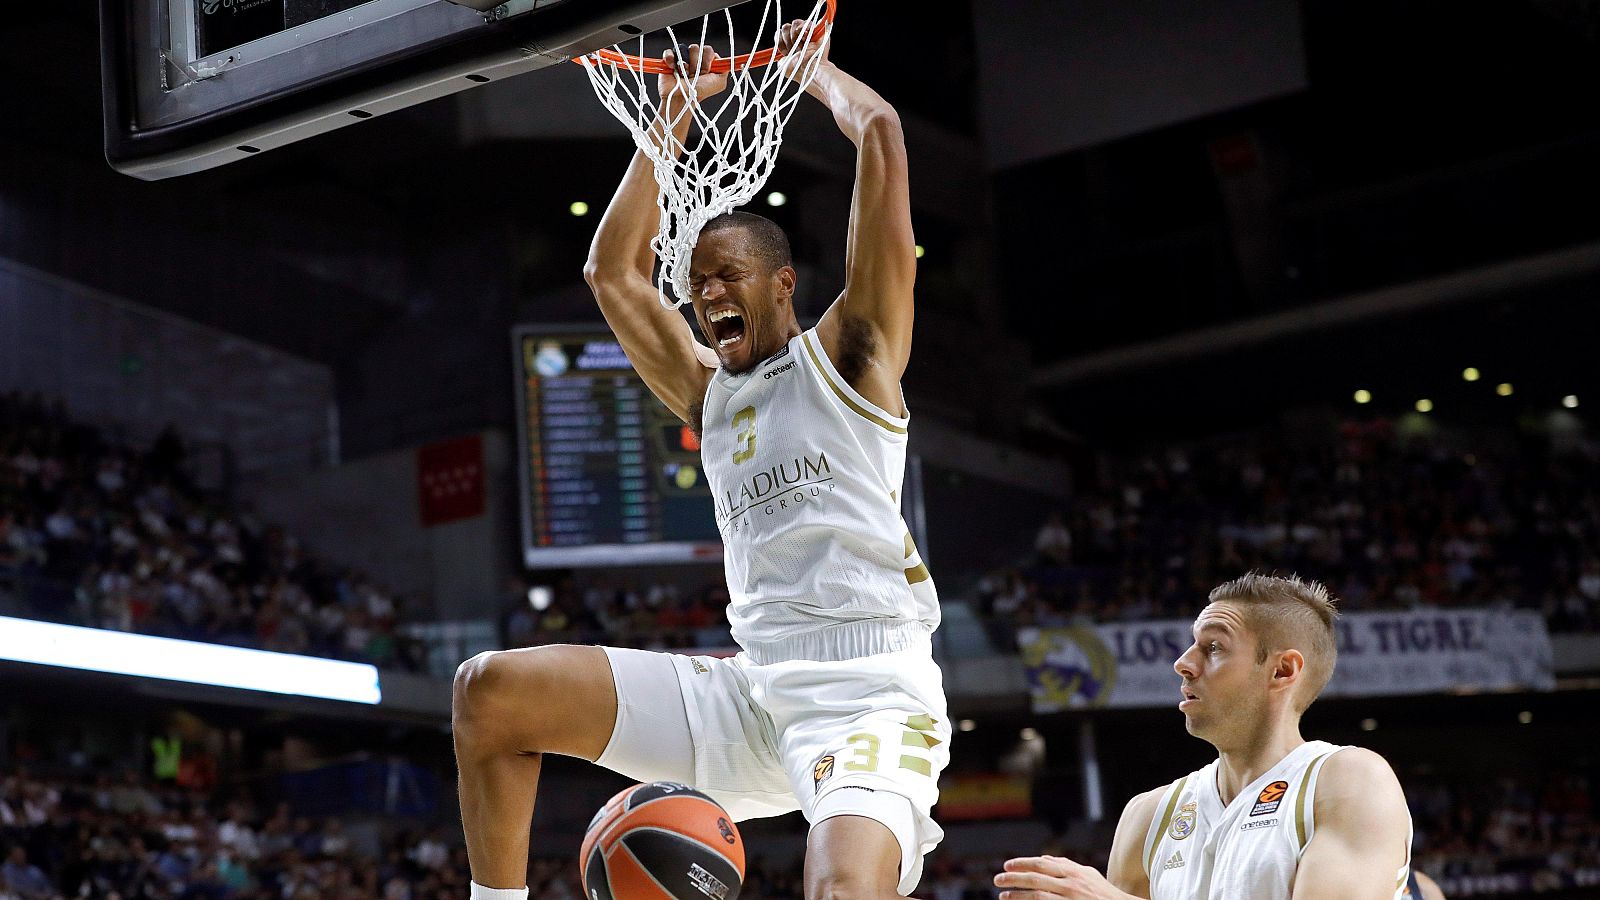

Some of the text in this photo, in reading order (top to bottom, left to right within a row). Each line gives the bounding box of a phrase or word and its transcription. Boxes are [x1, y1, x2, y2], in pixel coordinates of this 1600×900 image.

[732, 405, 756, 465] 3
[715, 451, 831, 521] ALLADIUM
[765, 483, 835, 515] GROUP
[1114, 630, 1184, 664] LOS
[1371, 617, 1482, 655] TIGRE
[844, 733, 879, 771] 3
